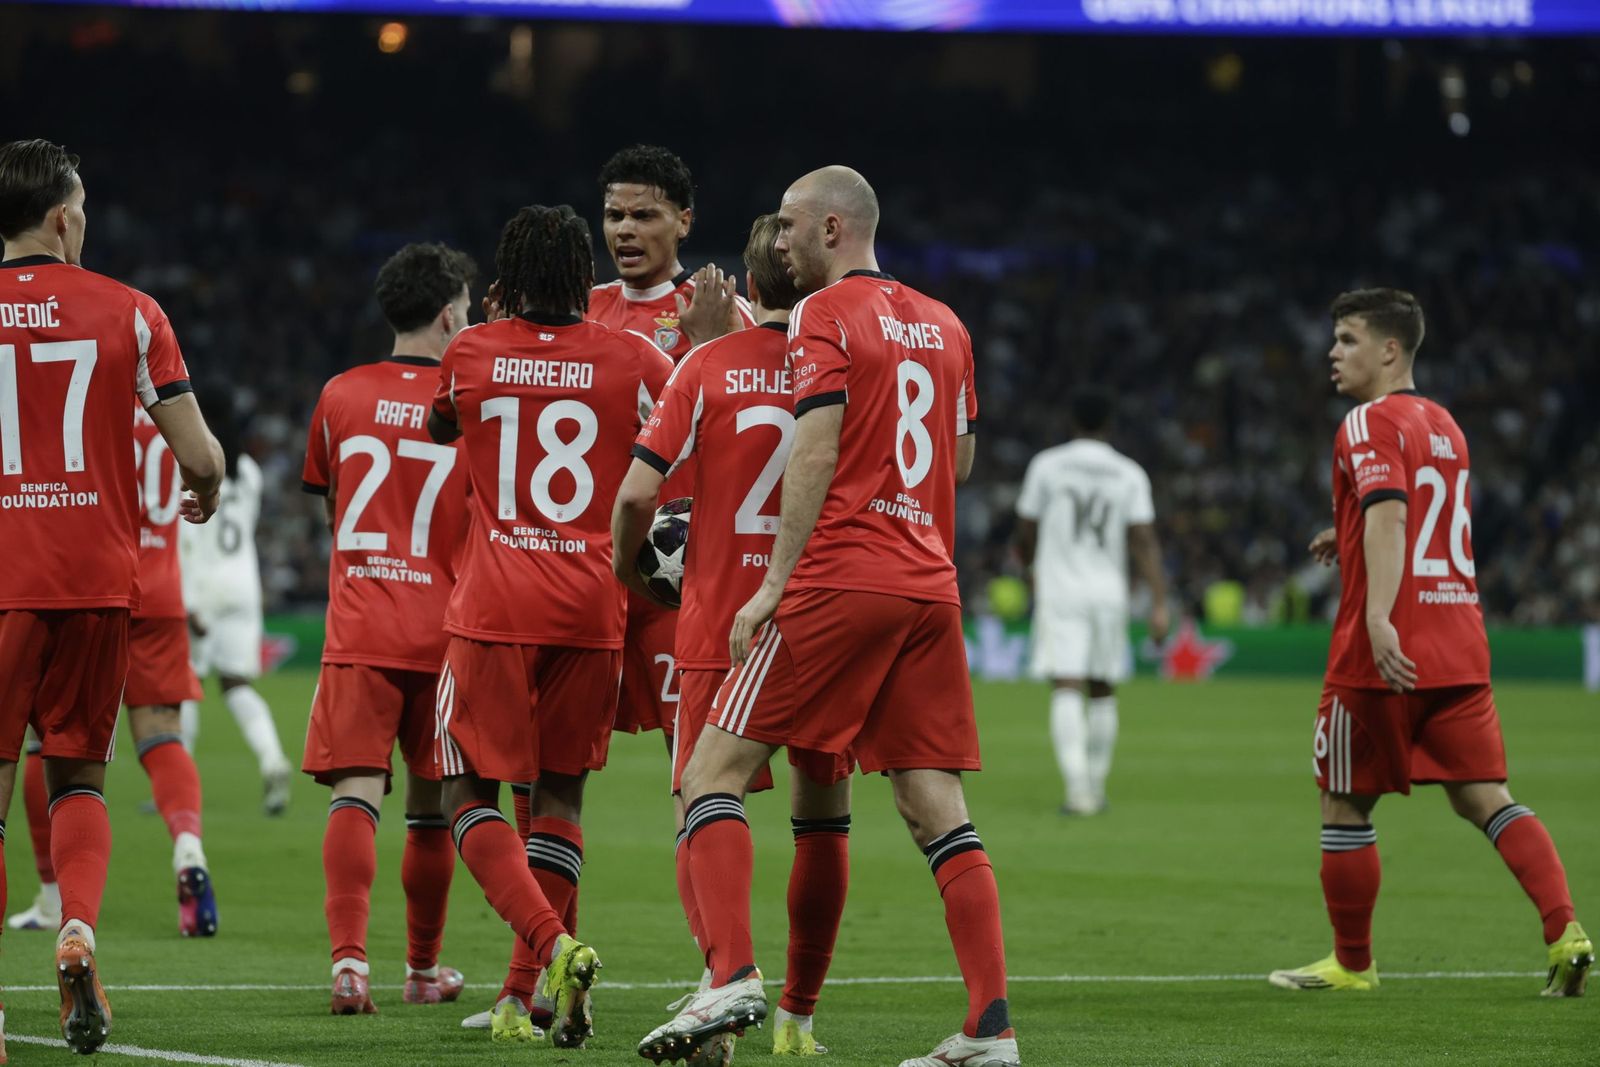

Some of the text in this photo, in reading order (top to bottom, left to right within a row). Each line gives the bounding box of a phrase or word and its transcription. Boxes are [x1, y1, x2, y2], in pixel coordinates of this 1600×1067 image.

[0, 295, 60, 328] DEDIĆ
[492, 357, 594, 389] BARREIRO
[0, 339, 98, 476] 17
[374, 399, 425, 430] RAFA
[895, 359, 935, 489] 8
[480, 396, 598, 523] 18
[735, 405, 797, 534] 2
[20, 482, 69, 493] BENFICA
[134, 432, 181, 526] 0
[0, 491, 98, 509] OUNDATION
[337, 434, 457, 558] 27
[512, 526, 559, 538] BENFICA
[1412, 465, 1476, 578] 26
[489, 529, 587, 553] FOUNDATION
[346, 565, 432, 585] FOUNDATION
[366, 555, 408, 568] BENFICA
[1313, 715, 1329, 759] 6
